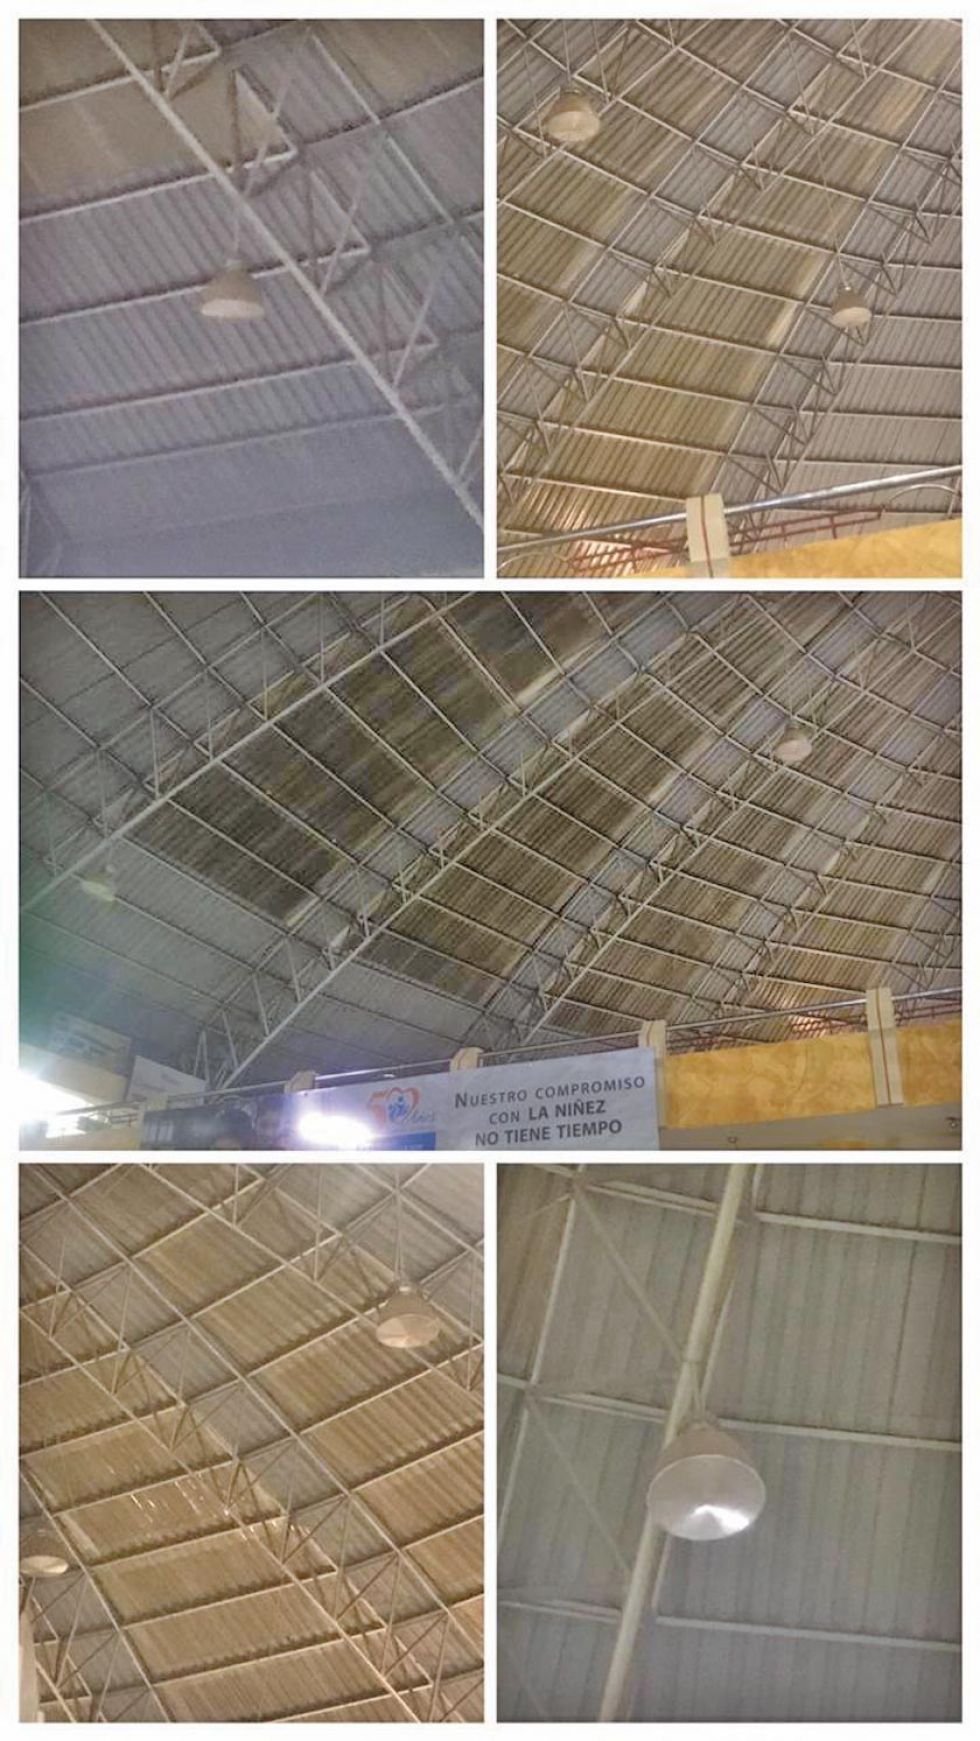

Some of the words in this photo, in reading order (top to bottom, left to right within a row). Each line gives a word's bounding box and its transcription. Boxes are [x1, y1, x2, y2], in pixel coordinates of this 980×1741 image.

[535, 1076, 645, 1100] COMPROMISO
[489, 1111, 520, 1125] CON
[529, 1106, 549, 1121] LA
[555, 1099, 606, 1118] NIÑEZ
[475, 1131, 499, 1147] NO
[504, 1127, 551, 1144] TIENE
[556, 1119, 622, 1138] TIEMPO
